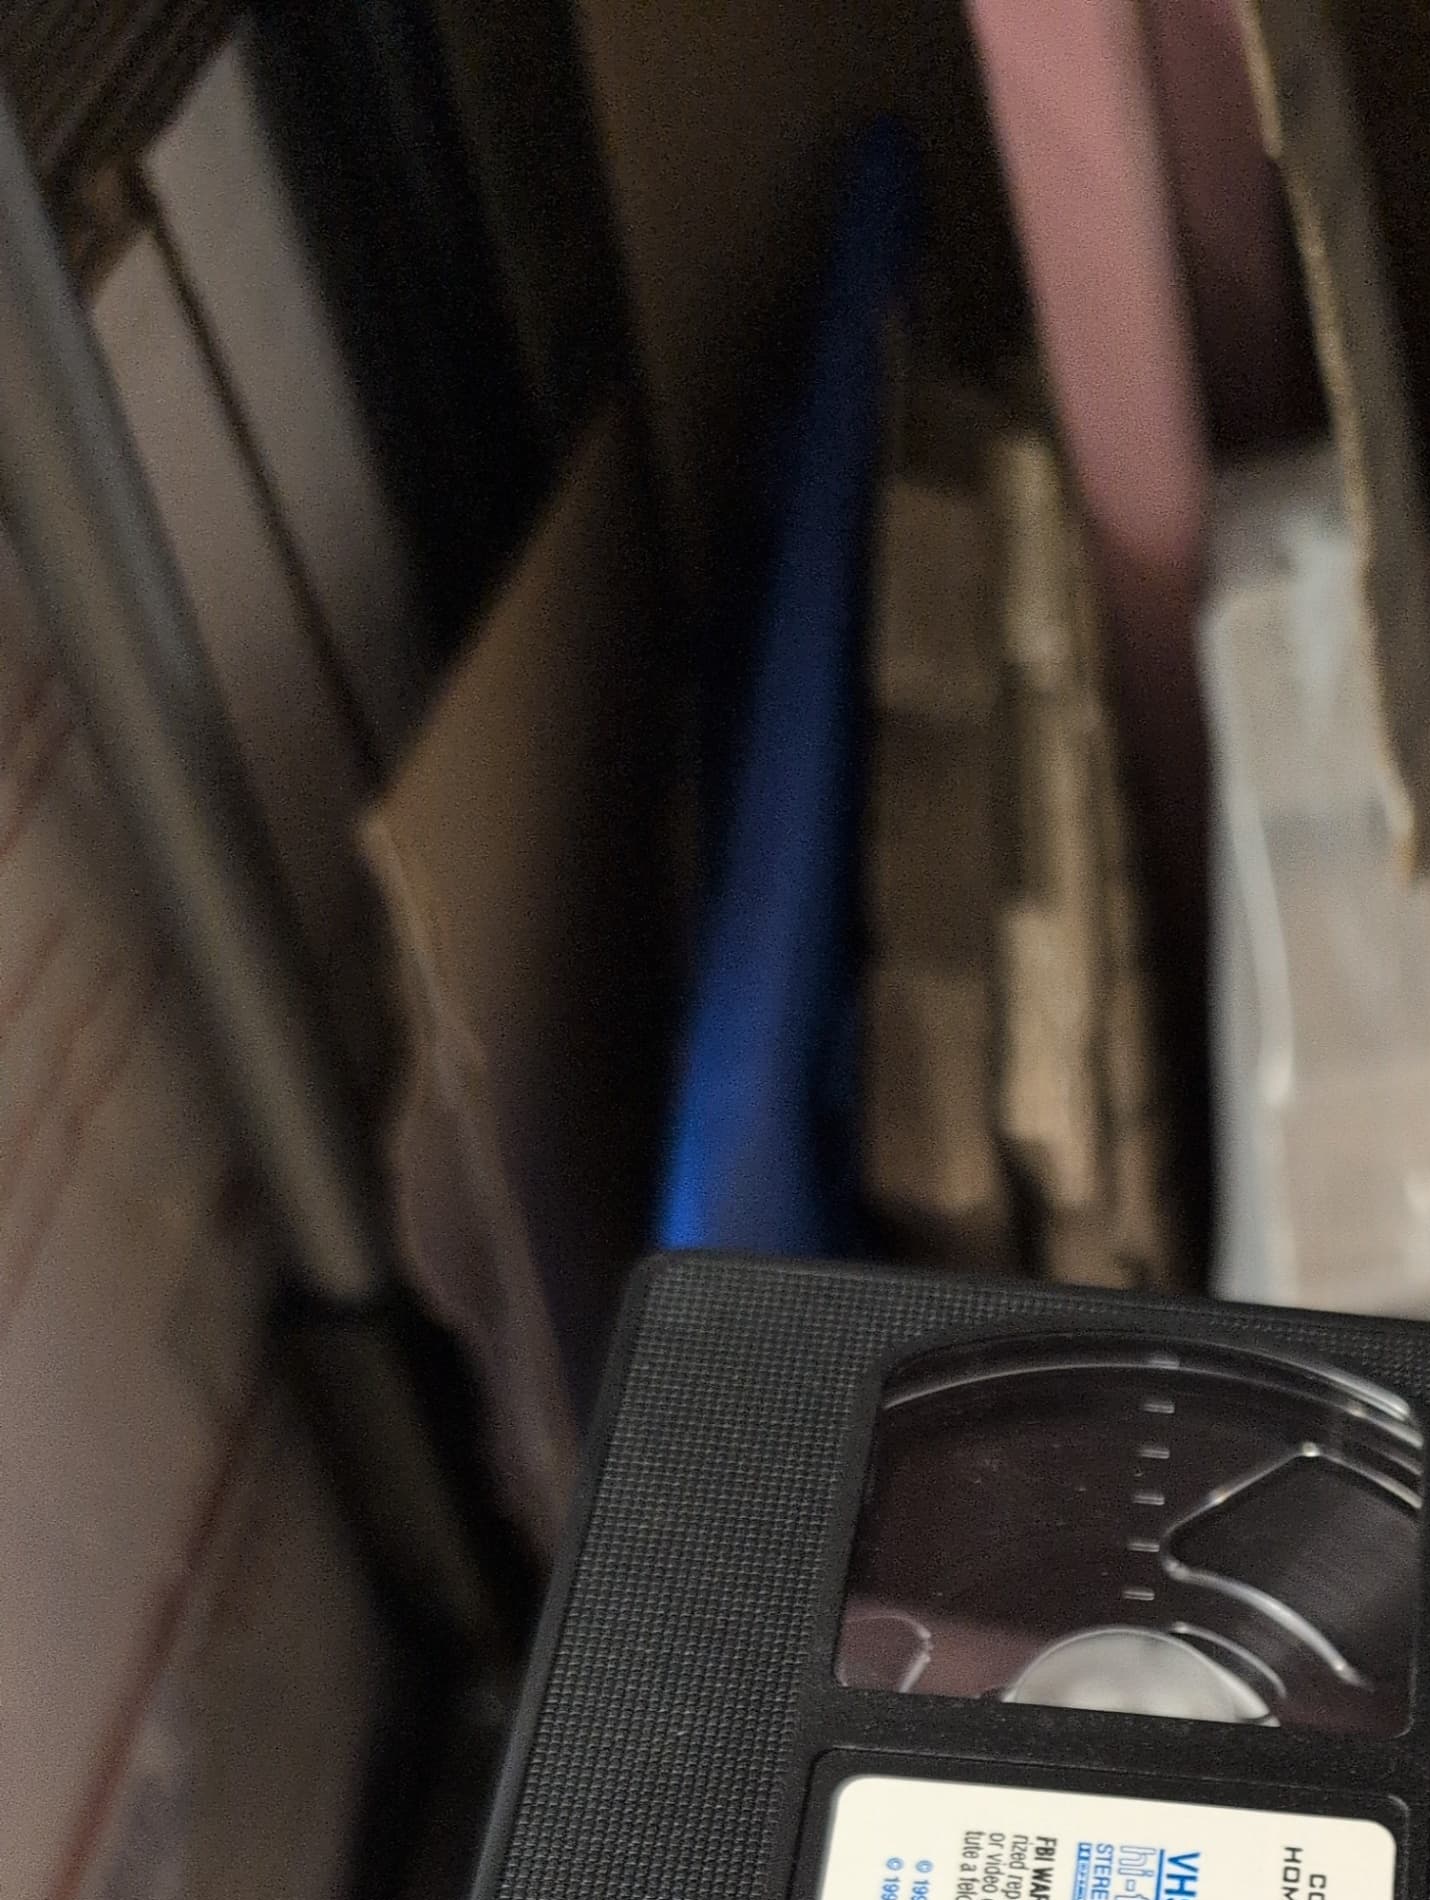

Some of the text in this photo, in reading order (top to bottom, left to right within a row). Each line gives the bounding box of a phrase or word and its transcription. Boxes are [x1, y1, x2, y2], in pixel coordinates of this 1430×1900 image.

[961, 1830, 986, 1859] tute
[987, 1831, 1006, 1849] or
[1033, 1835, 1057, 1862] FBI
[1007, 1833, 1033, 1871] rized
[884, 1856, 903, 1871] ©
[914, 1859, 933, 1873] ©
[959, 1862, 977, 1872] a
[980, 1852, 1007, 1894] video
